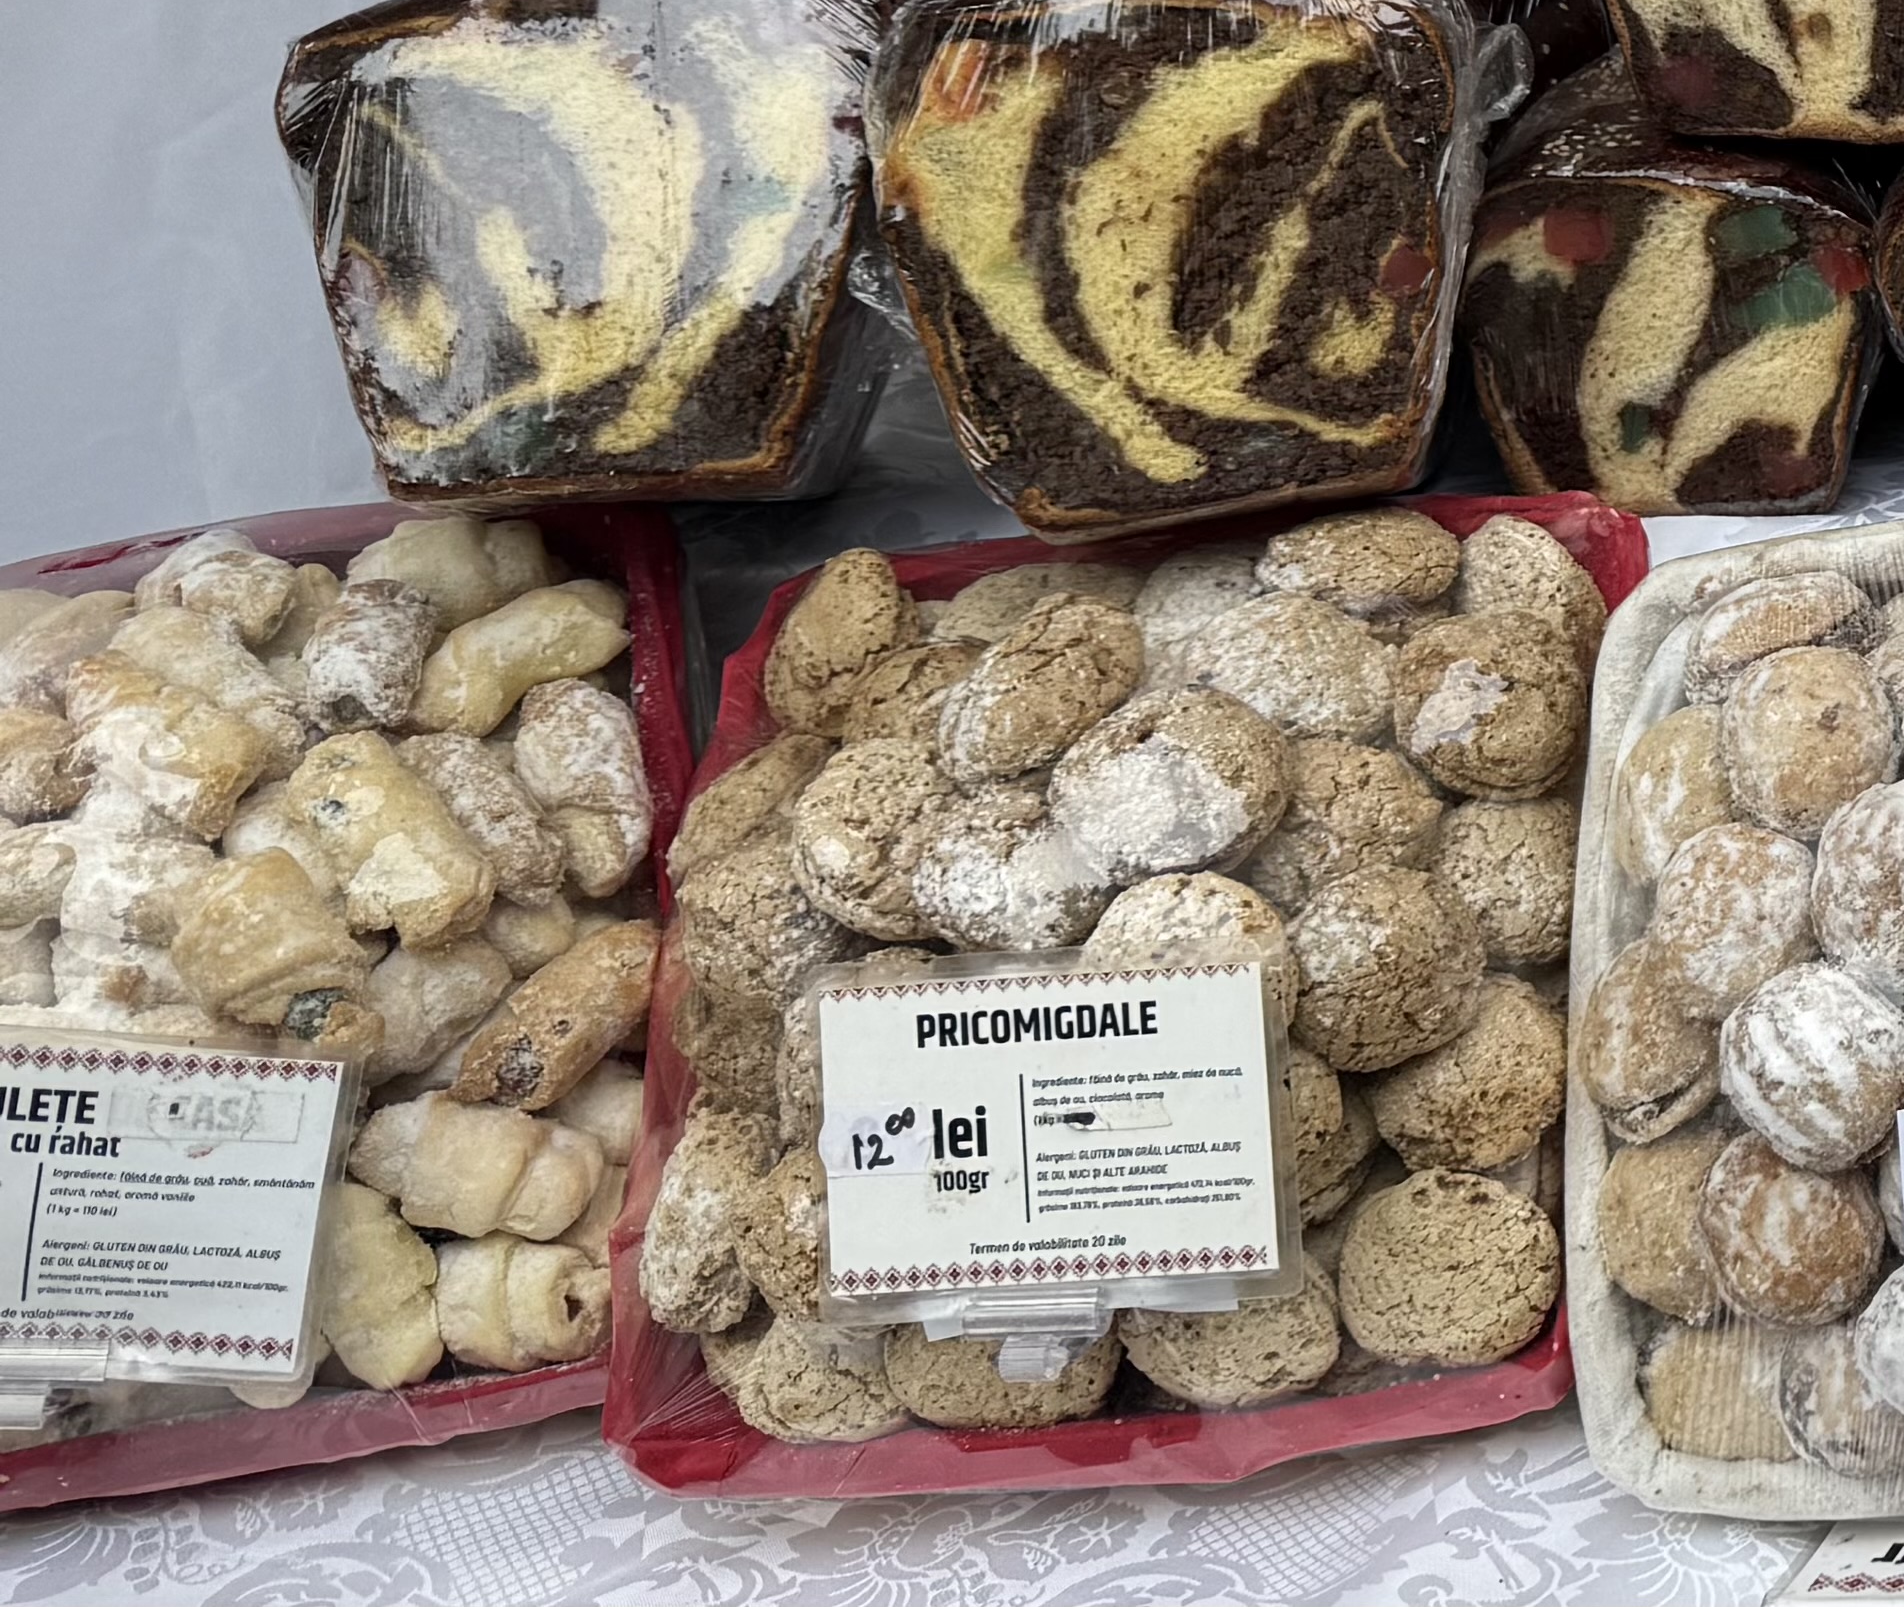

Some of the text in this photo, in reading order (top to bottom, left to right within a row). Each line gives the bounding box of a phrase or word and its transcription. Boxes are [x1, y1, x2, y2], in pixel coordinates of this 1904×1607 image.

[916, 1000, 1159, 1049] PRICOMIGDALE
[11, 1131, 121, 1158] cu rahat
[932, 1105, 988, 1160] lei
[933, 1169, 990, 1195] 100gr
[970, 1243, 1009, 1255] Termen
[1012, 1241, 1025, 1252] de
[1092, 1235, 1105, 1247] 20
